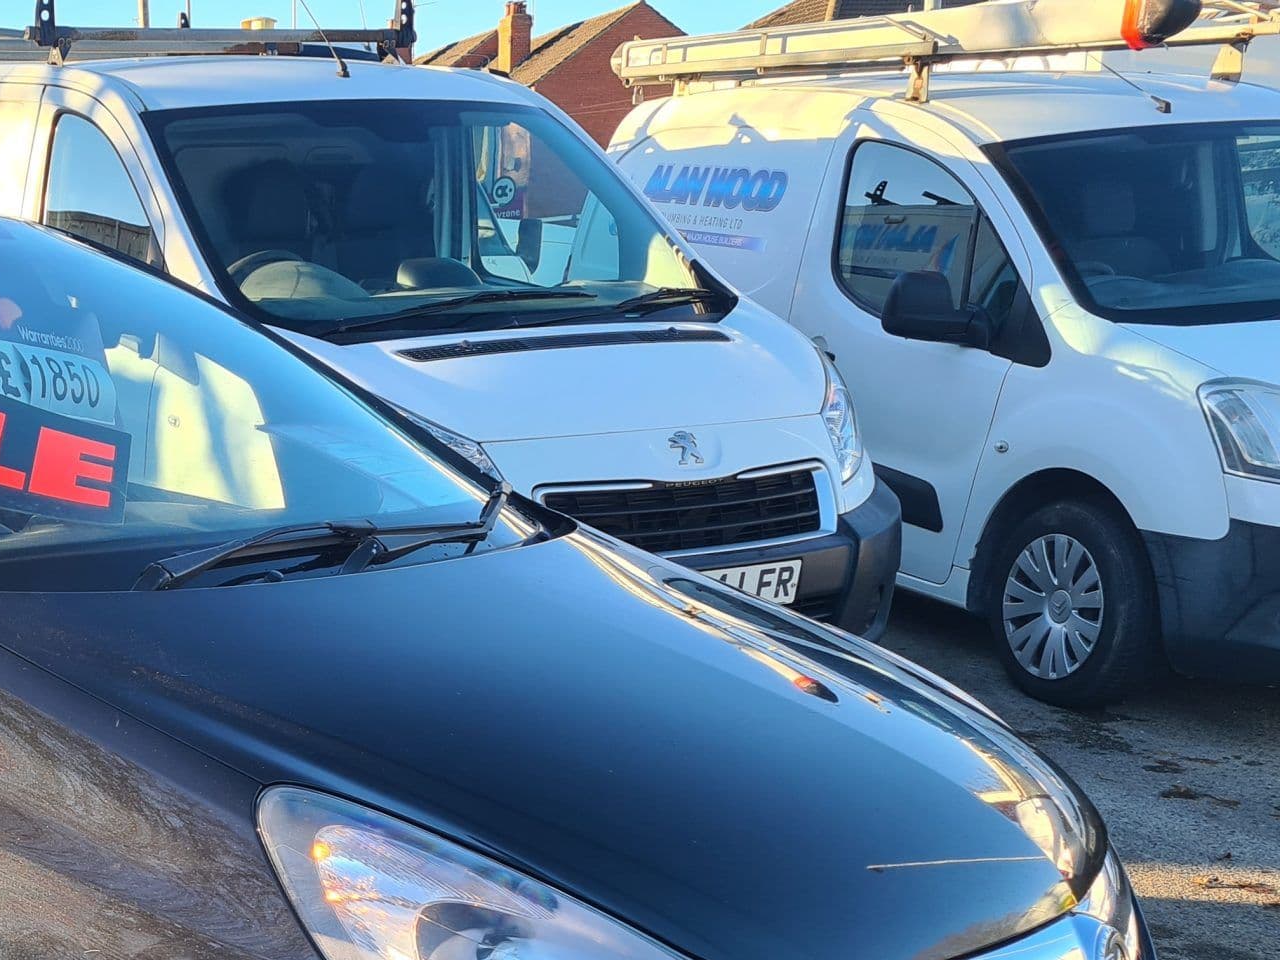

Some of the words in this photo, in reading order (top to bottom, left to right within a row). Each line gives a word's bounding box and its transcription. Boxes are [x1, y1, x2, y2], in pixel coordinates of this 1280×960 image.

[642, 165, 710, 205] ALAN
[703, 167, 788, 212] WOOD
[665, 479, 724, 488] PEUGEOT
